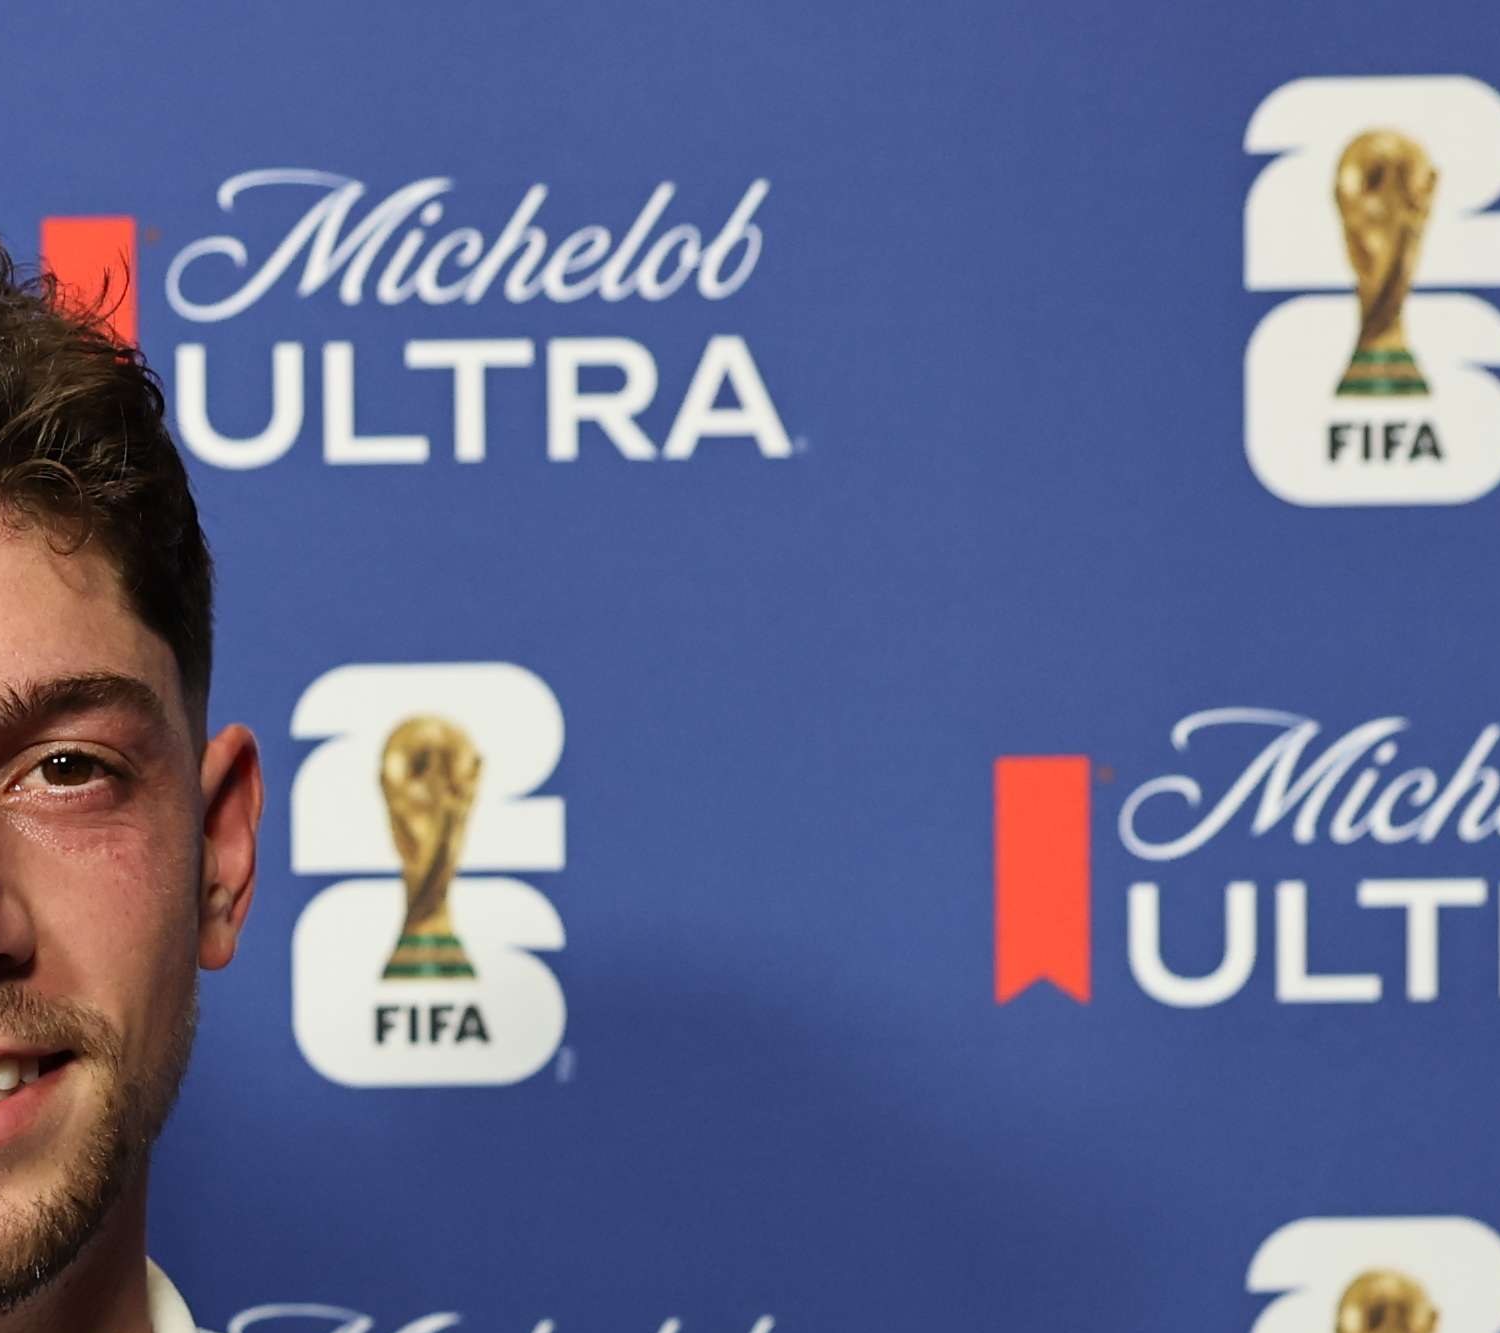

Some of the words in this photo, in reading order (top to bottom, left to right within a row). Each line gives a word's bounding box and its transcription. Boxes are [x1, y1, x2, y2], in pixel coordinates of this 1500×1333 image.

[165, 167, 771, 324] Michelob
[173, 334, 794, 471] ULTRA
[1326, 420, 1445, 465] FIFA
[373, 1002, 493, 1047] FIFA
